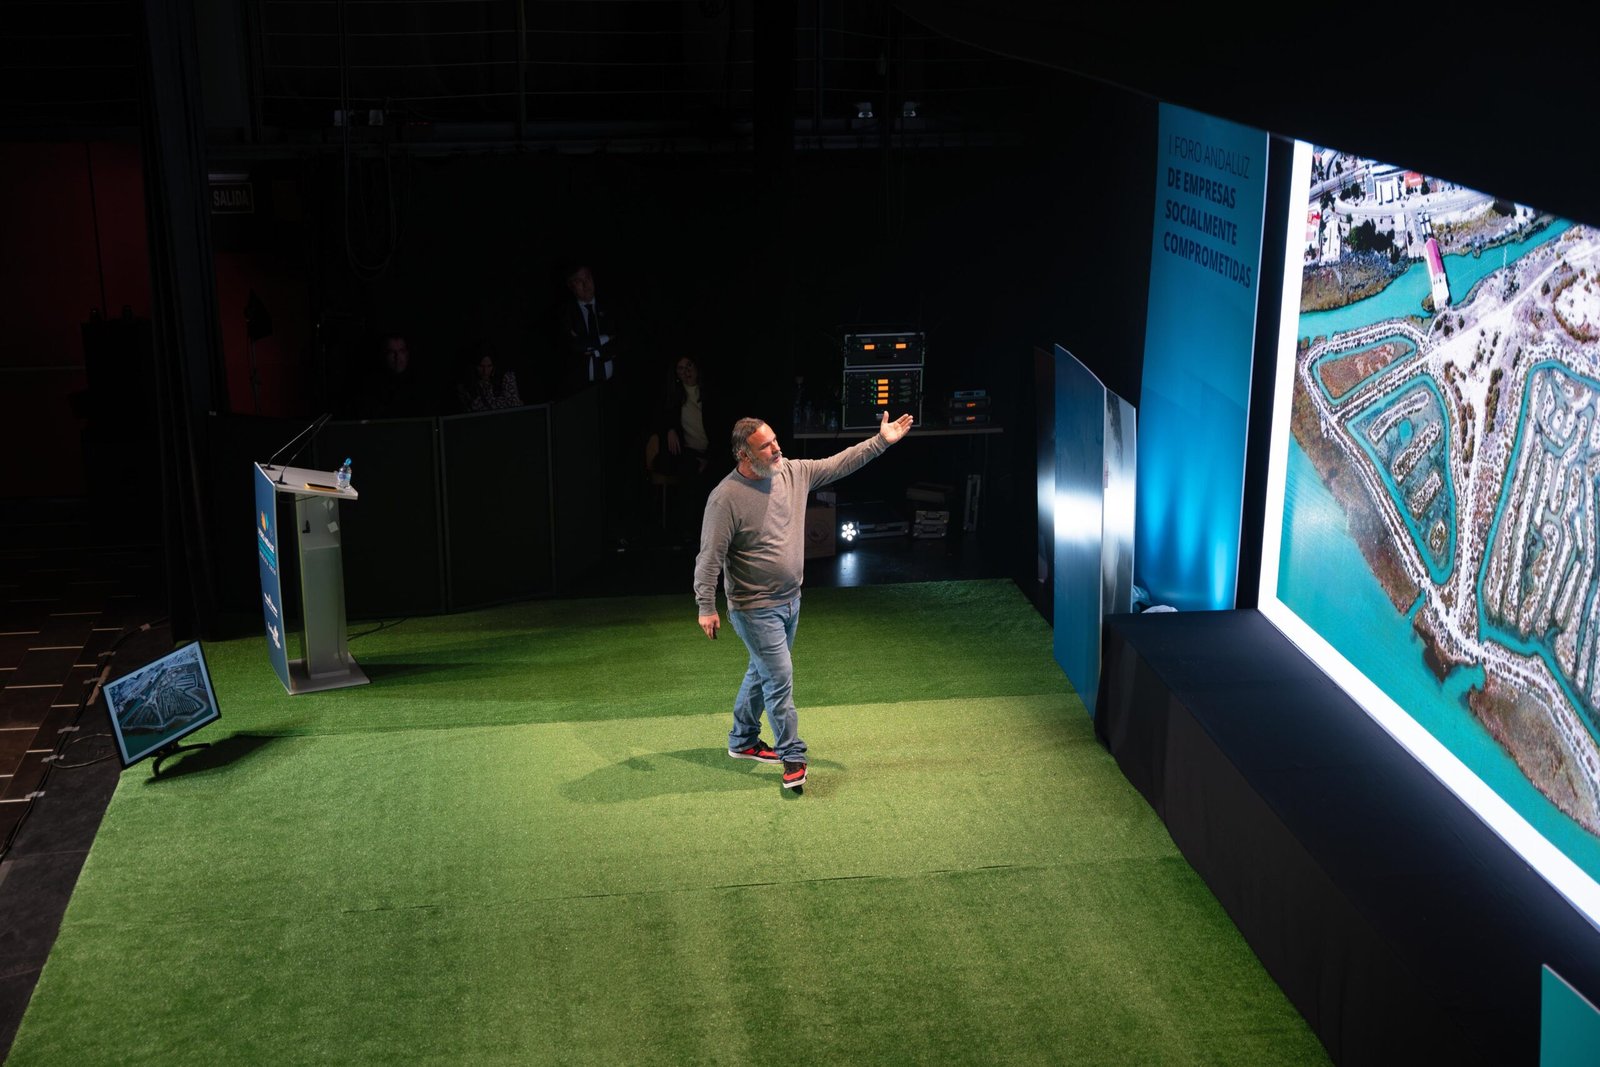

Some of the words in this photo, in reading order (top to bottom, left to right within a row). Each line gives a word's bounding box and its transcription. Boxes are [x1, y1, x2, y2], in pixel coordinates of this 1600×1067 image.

[1174, 136, 1202, 163] FORO
[1204, 144, 1250, 179] ANDALUZ
[213, 189, 249, 207] SALIDA
[1167, 167, 1181, 190] DE
[1183, 172, 1236, 209] EMPRESAS
[1165, 199, 1238, 245] SOCIALMENTE
[1163, 231, 1251, 289] COMPROMETIDAS
